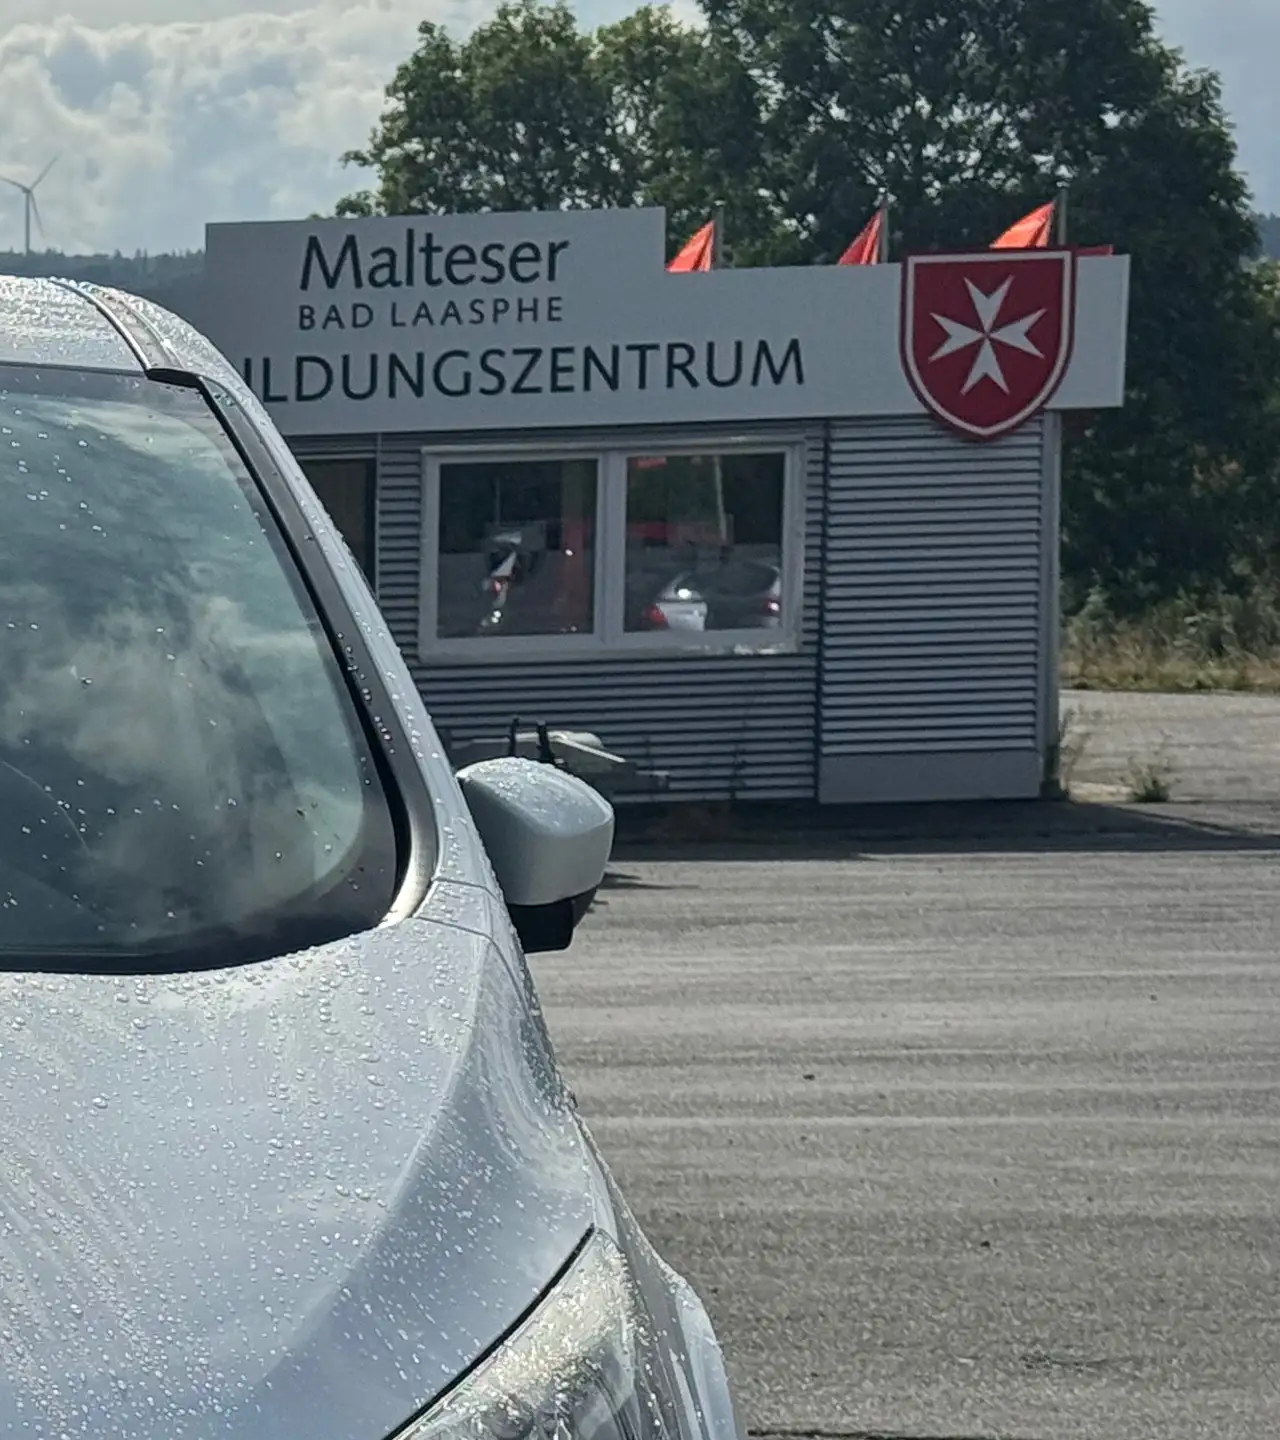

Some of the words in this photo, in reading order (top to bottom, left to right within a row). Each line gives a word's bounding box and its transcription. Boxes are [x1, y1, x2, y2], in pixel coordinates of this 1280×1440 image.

[299, 227, 571, 292] Malteser
[298, 302, 375, 331] BAD
[390, 297, 564, 328] LAASPHE
